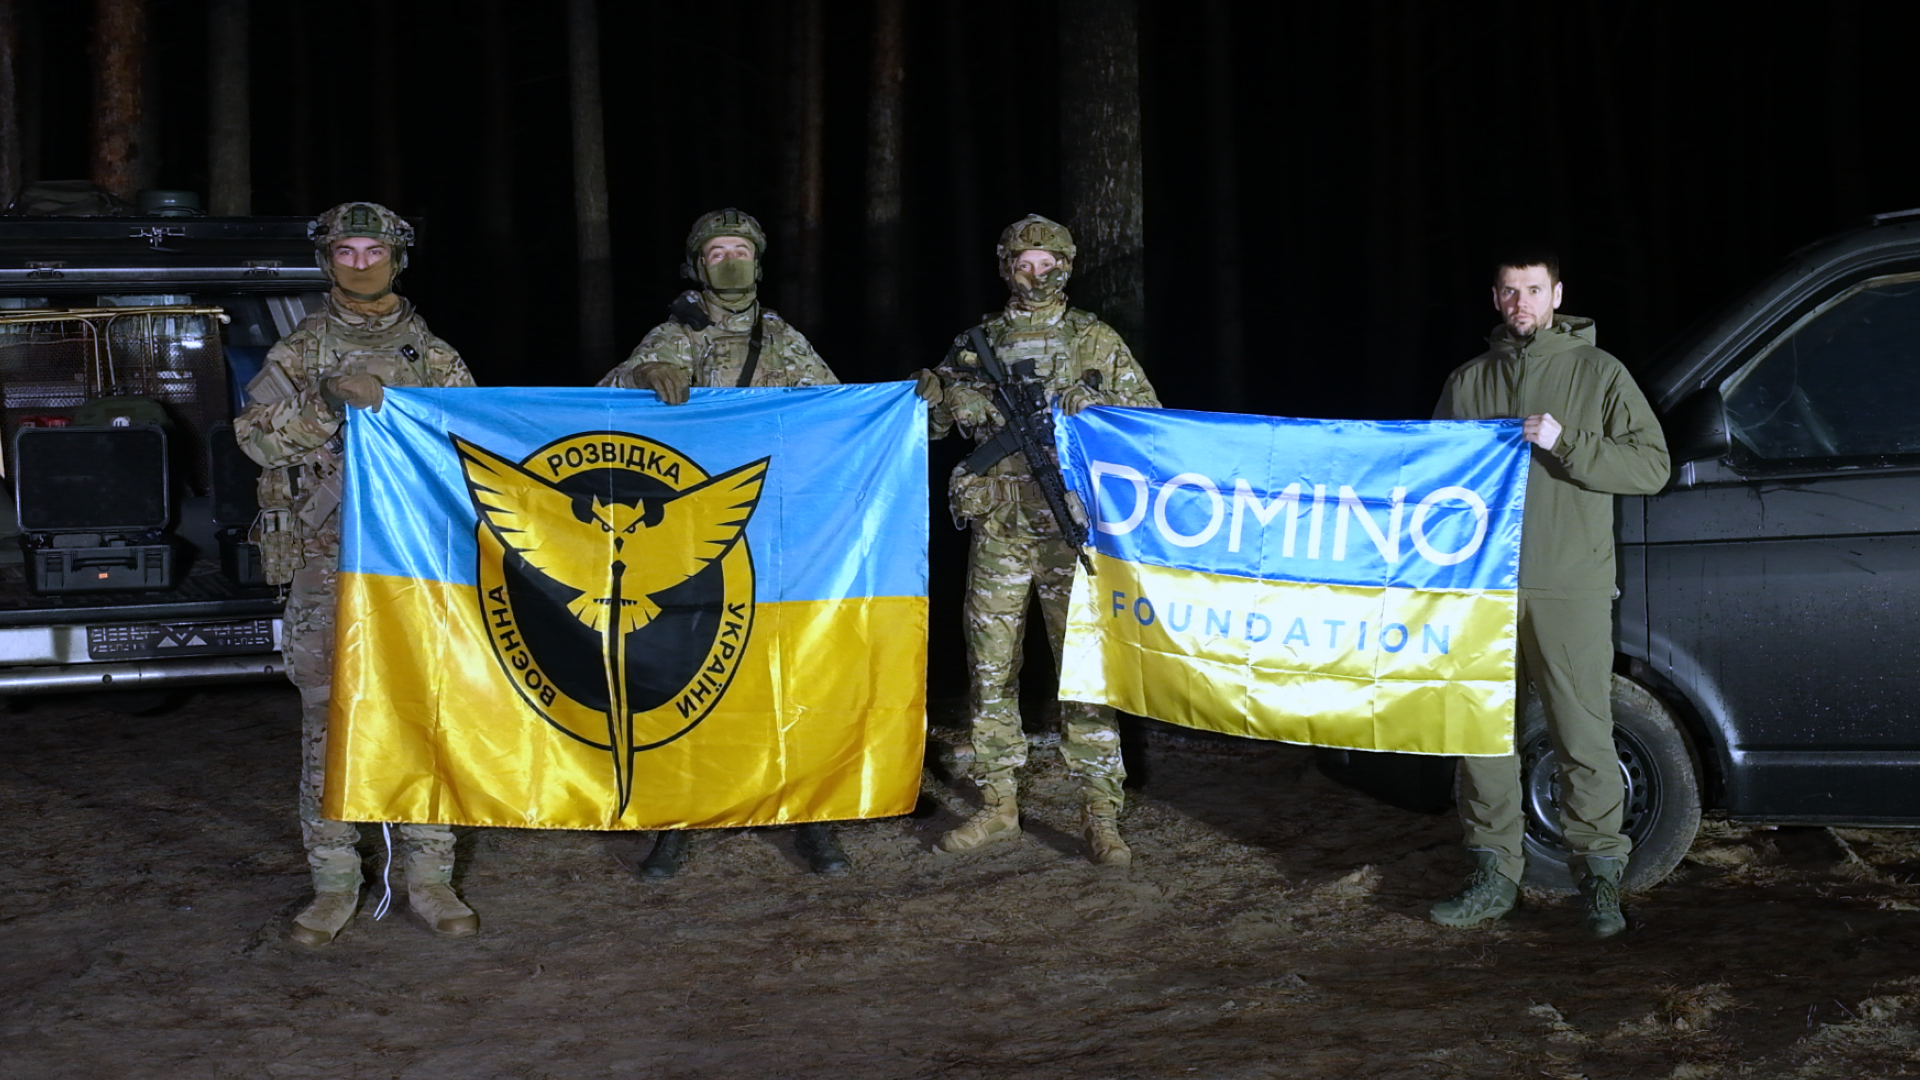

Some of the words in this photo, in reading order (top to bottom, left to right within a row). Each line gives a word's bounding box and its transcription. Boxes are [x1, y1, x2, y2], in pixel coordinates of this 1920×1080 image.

[546, 442, 681, 485] РОЗВІДКА
[1090, 459, 1489, 567] DOMINO
[488, 585, 557, 708] ВОЄННА
[675, 602, 746, 720] УКРАЇНИ
[1111, 589, 1451, 655] FOUNDATION
